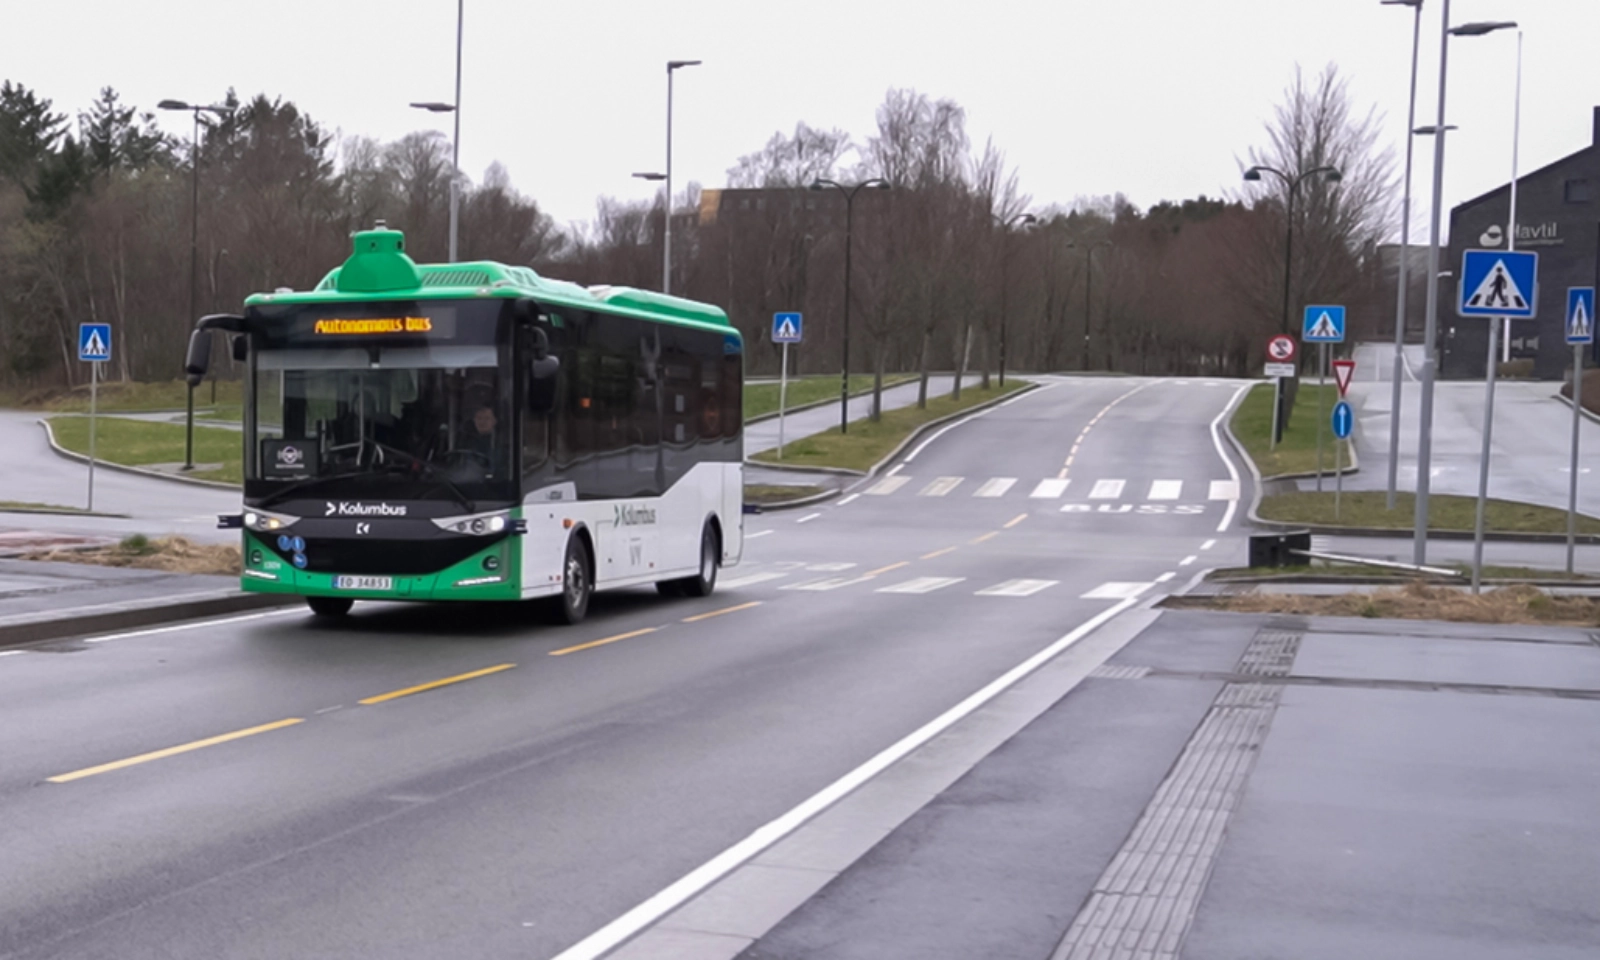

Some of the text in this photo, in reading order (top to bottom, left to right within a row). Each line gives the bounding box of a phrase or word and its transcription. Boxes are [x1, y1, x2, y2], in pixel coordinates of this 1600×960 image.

[314, 317, 432, 334] Autonomous bus
[338, 502, 407, 516] Kolumbus
